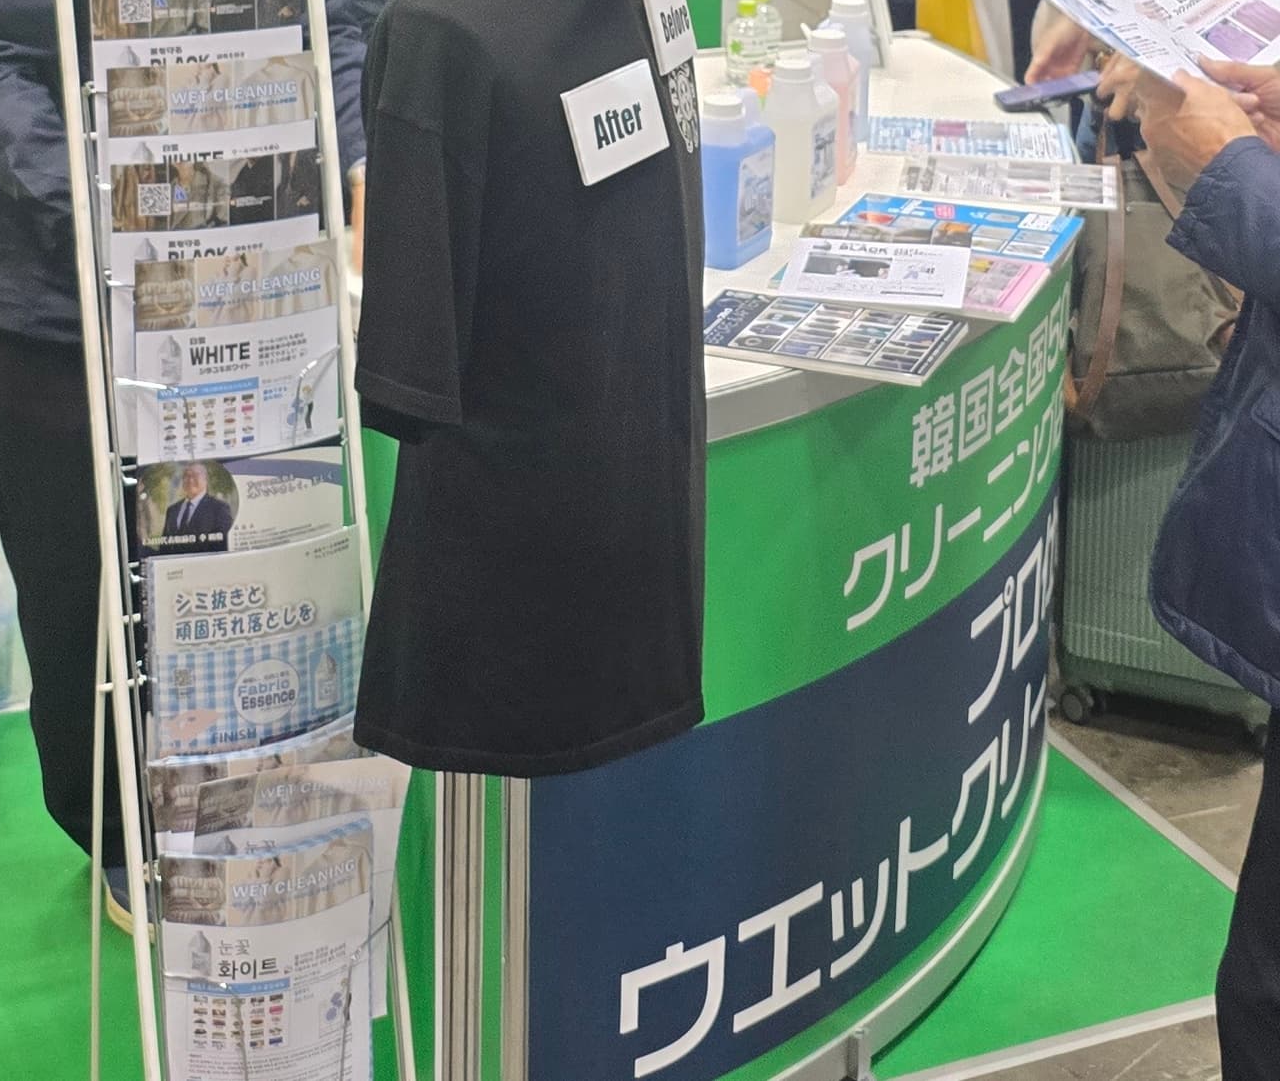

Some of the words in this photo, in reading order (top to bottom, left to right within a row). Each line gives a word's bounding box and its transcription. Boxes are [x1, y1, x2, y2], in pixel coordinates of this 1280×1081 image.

[659, 3, 690, 44] Before
[170, 90, 209, 105] WET
[213, 80, 297, 103] CLEANING
[593, 100, 642, 150] After
[199, 281, 235, 298] WET
[241, 268, 320, 295] CLEANING
[189, 341, 251, 367] WHITE
[175, 586, 261, 613] シミ抜きと
[175, 603, 312, 641] 頑固汚れ落としを
[237, 677, 290, 697] Fabric
[241, 689, 296, 711] Essence
[260, 784, 297, 799] WET
[300, 776, 388, 794] CLENING
[232, 884, 269, 898] WET
[275, 859, 356, 895] CLEANING
[218, 958, 279, 980] 화이트
